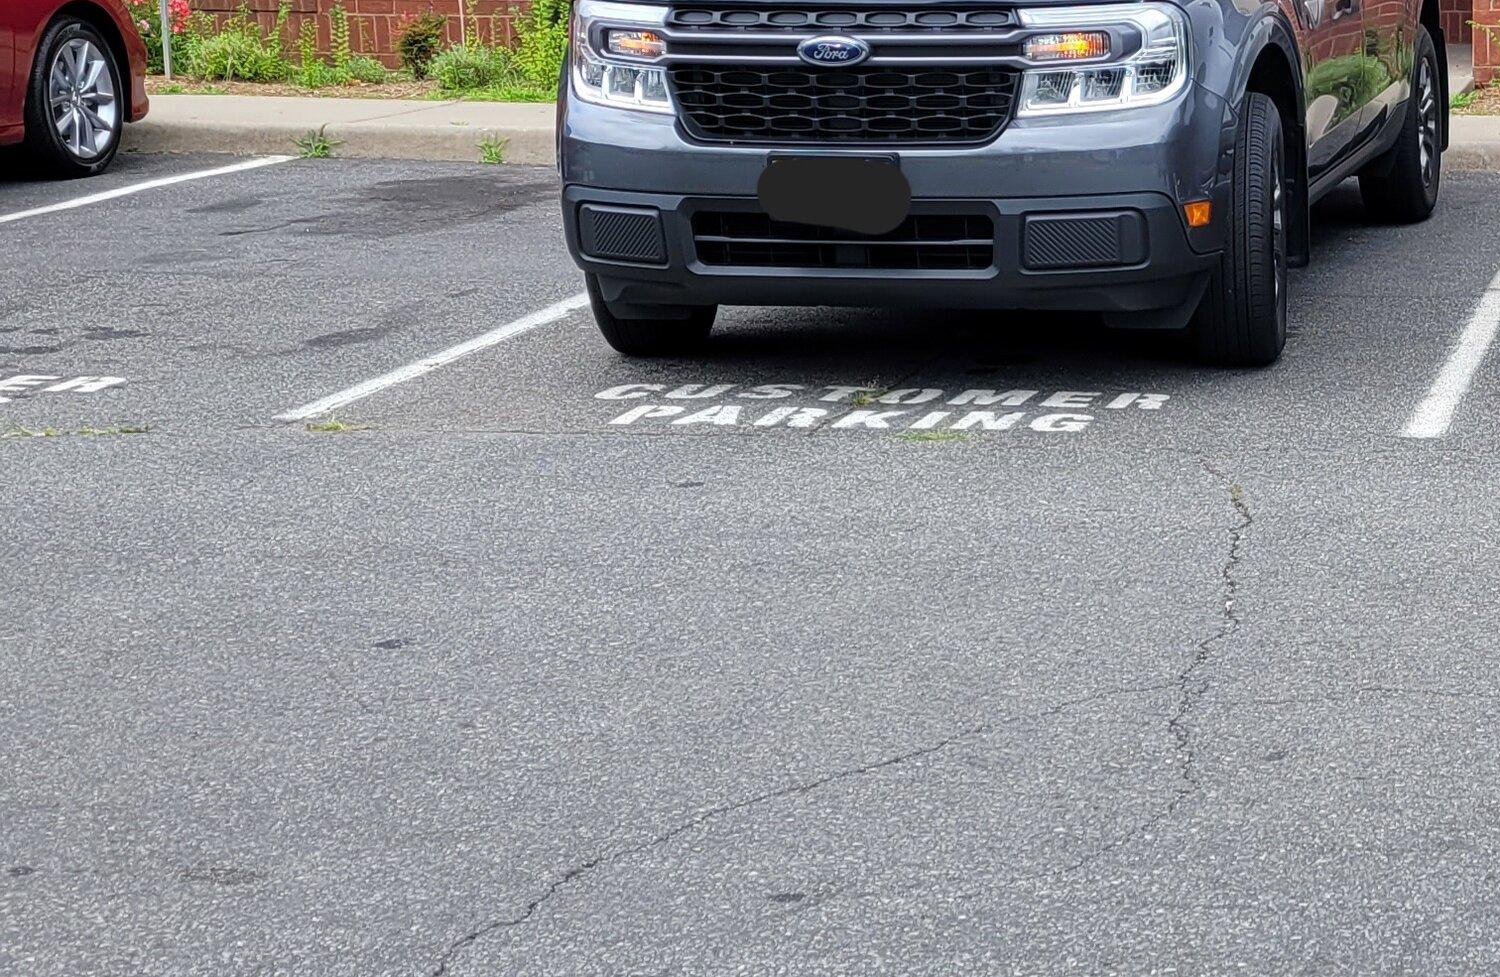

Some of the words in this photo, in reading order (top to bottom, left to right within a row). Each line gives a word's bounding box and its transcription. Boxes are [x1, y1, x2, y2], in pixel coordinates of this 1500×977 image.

[813, 43, 849, 60] Ford
[594, 383, 1170, 410] CUSTOMER
[606, 404, 1096, 432] PARKING
